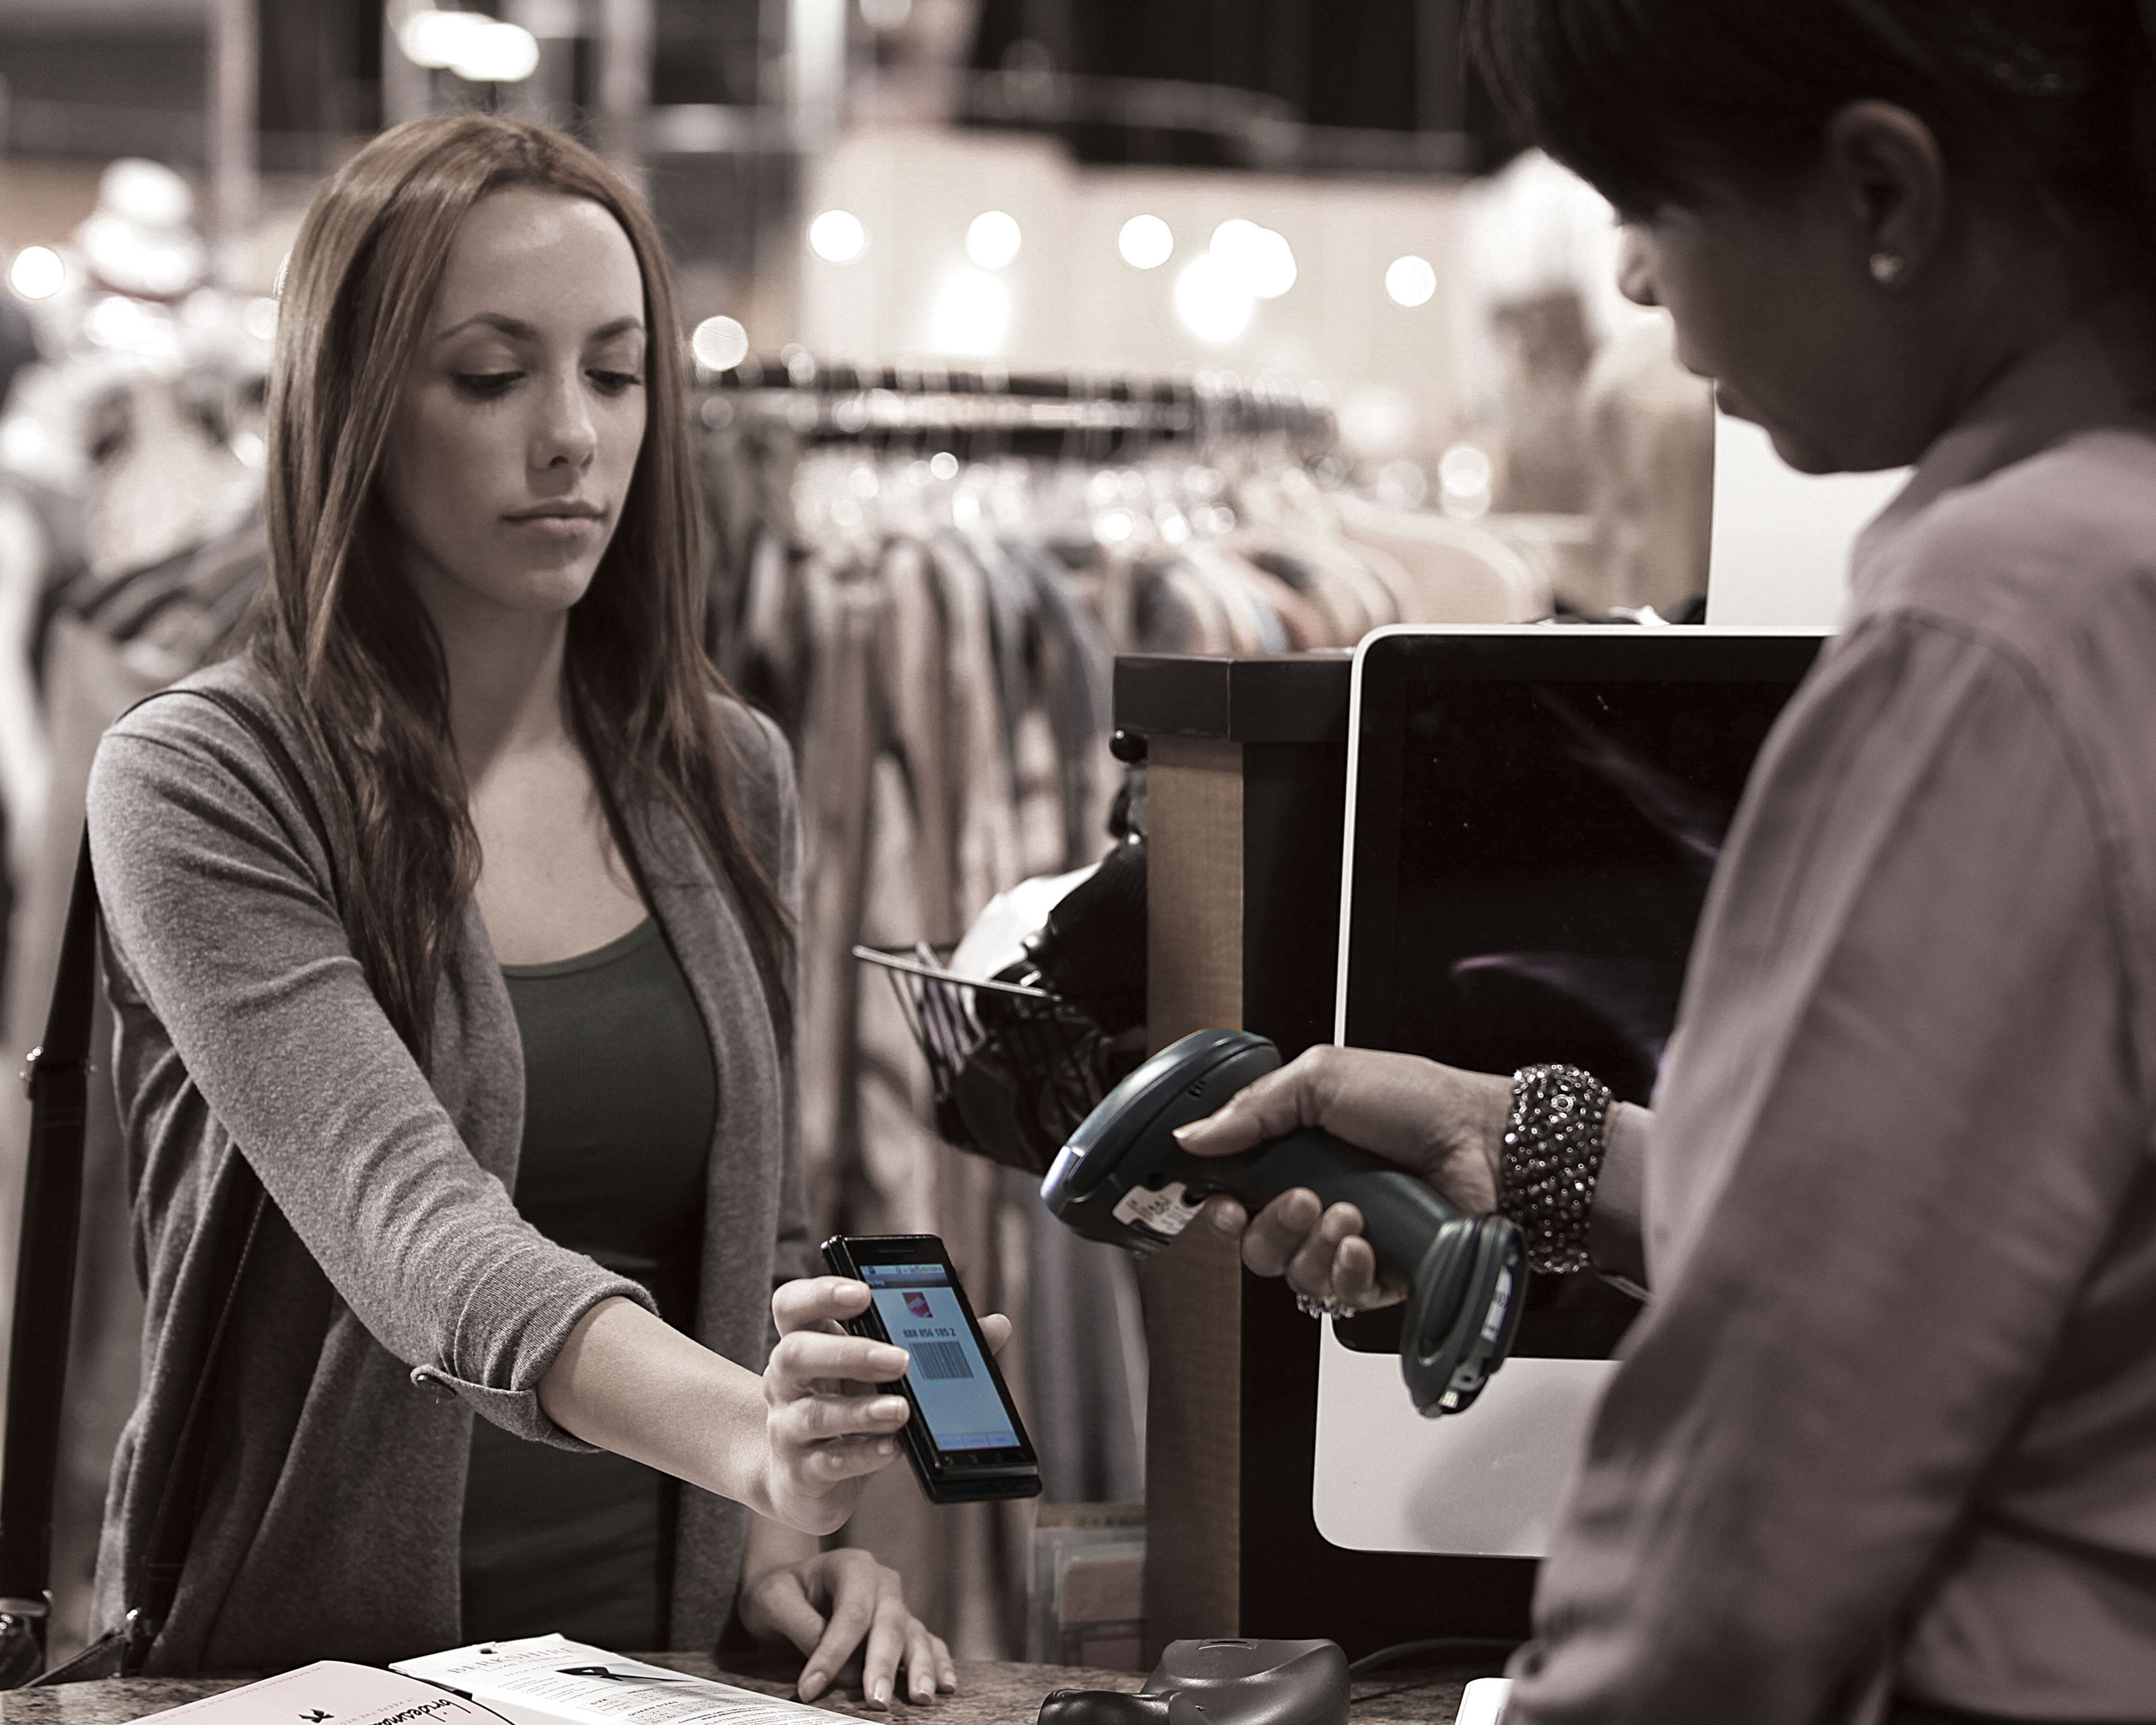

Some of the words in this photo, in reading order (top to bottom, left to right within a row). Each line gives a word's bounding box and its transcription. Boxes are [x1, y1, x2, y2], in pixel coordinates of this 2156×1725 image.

[903, 1329, 918, 1337] 888
[950, 1328, 956, 1336] 2
[447, 1648, 578, 1673] BERKSHIRE
[377, 1702, 404, 1712] KEEPS
